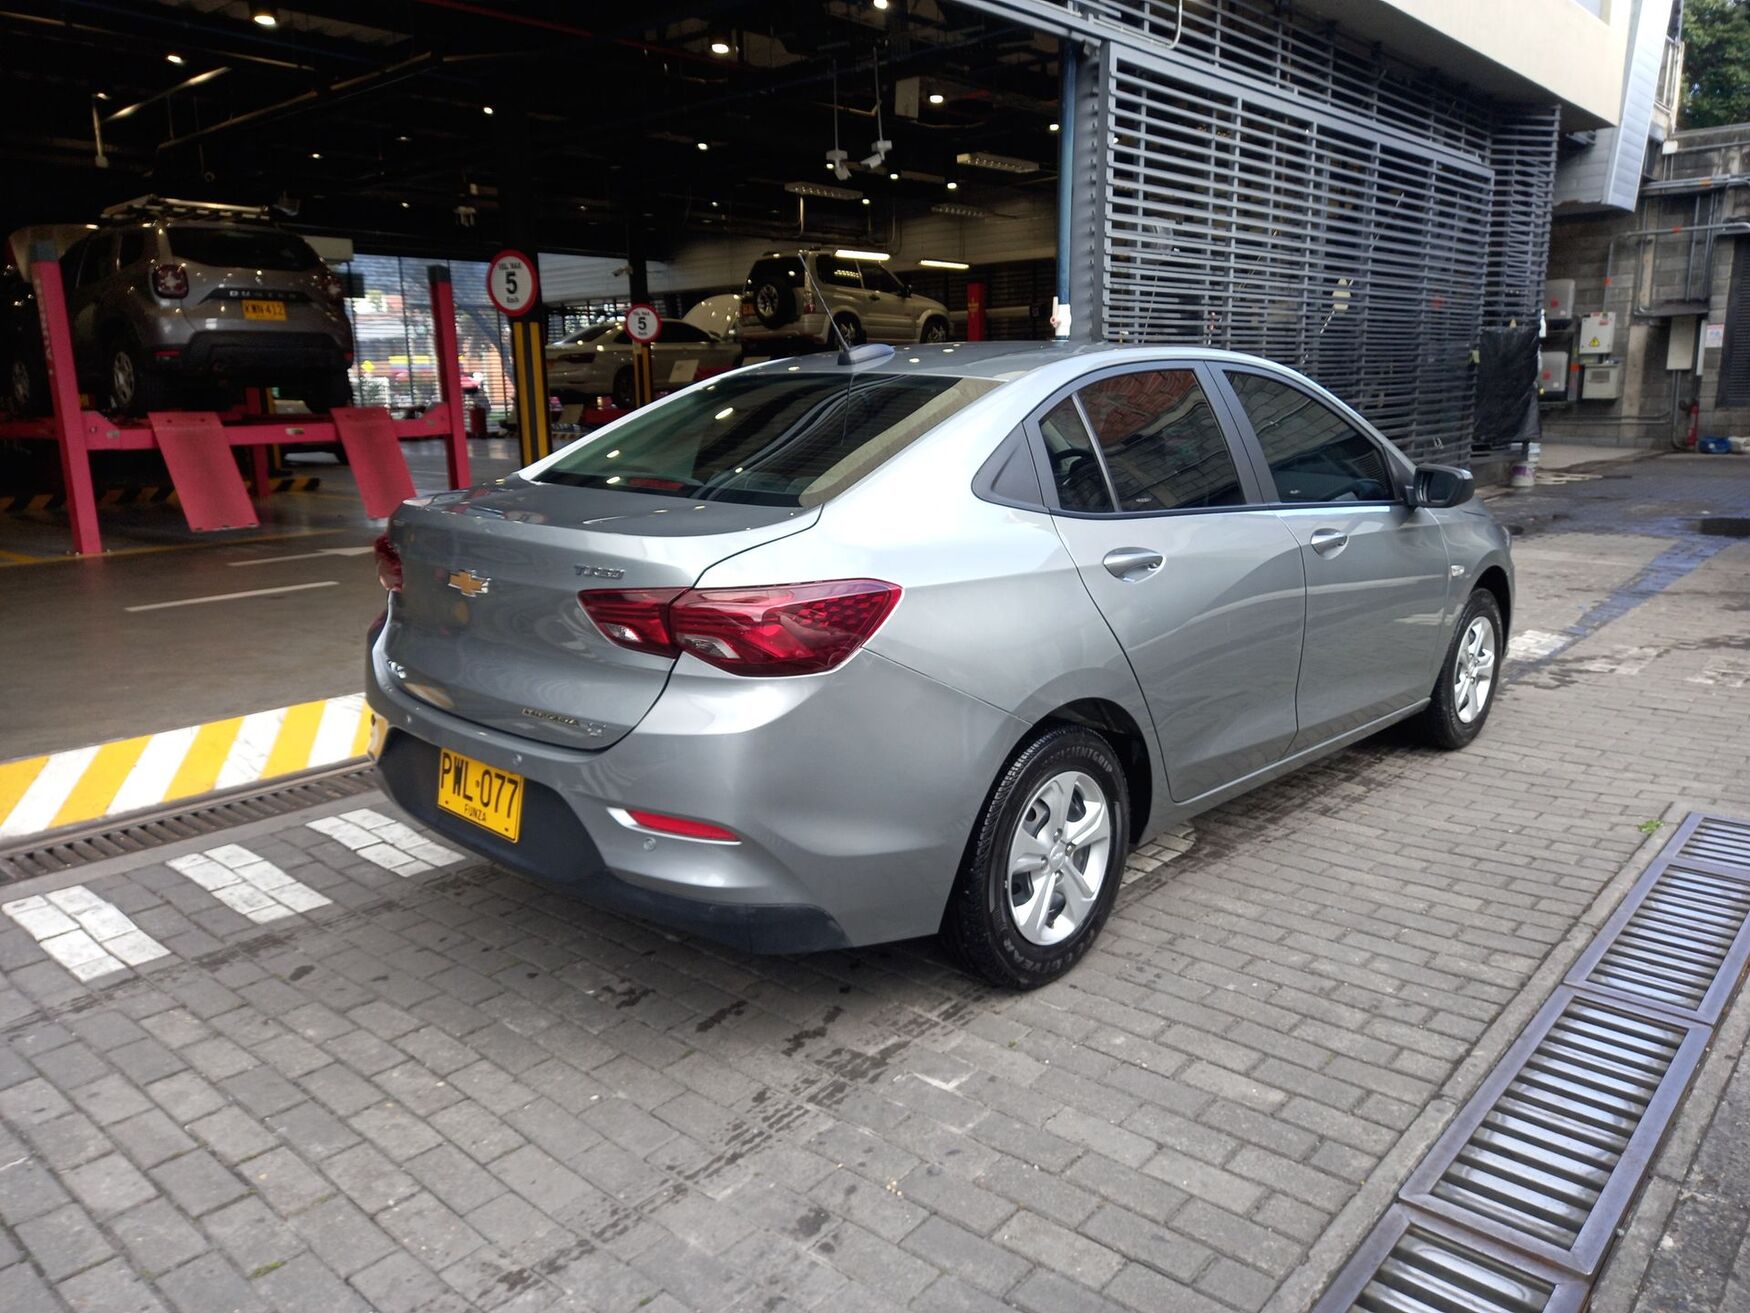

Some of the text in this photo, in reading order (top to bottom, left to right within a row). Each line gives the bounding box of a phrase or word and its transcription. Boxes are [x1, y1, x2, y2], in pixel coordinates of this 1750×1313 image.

[506, 271, 518, 295] 5
[638, 316, 647, 331] 5
[464, 804, 487, 822] FUNZA
